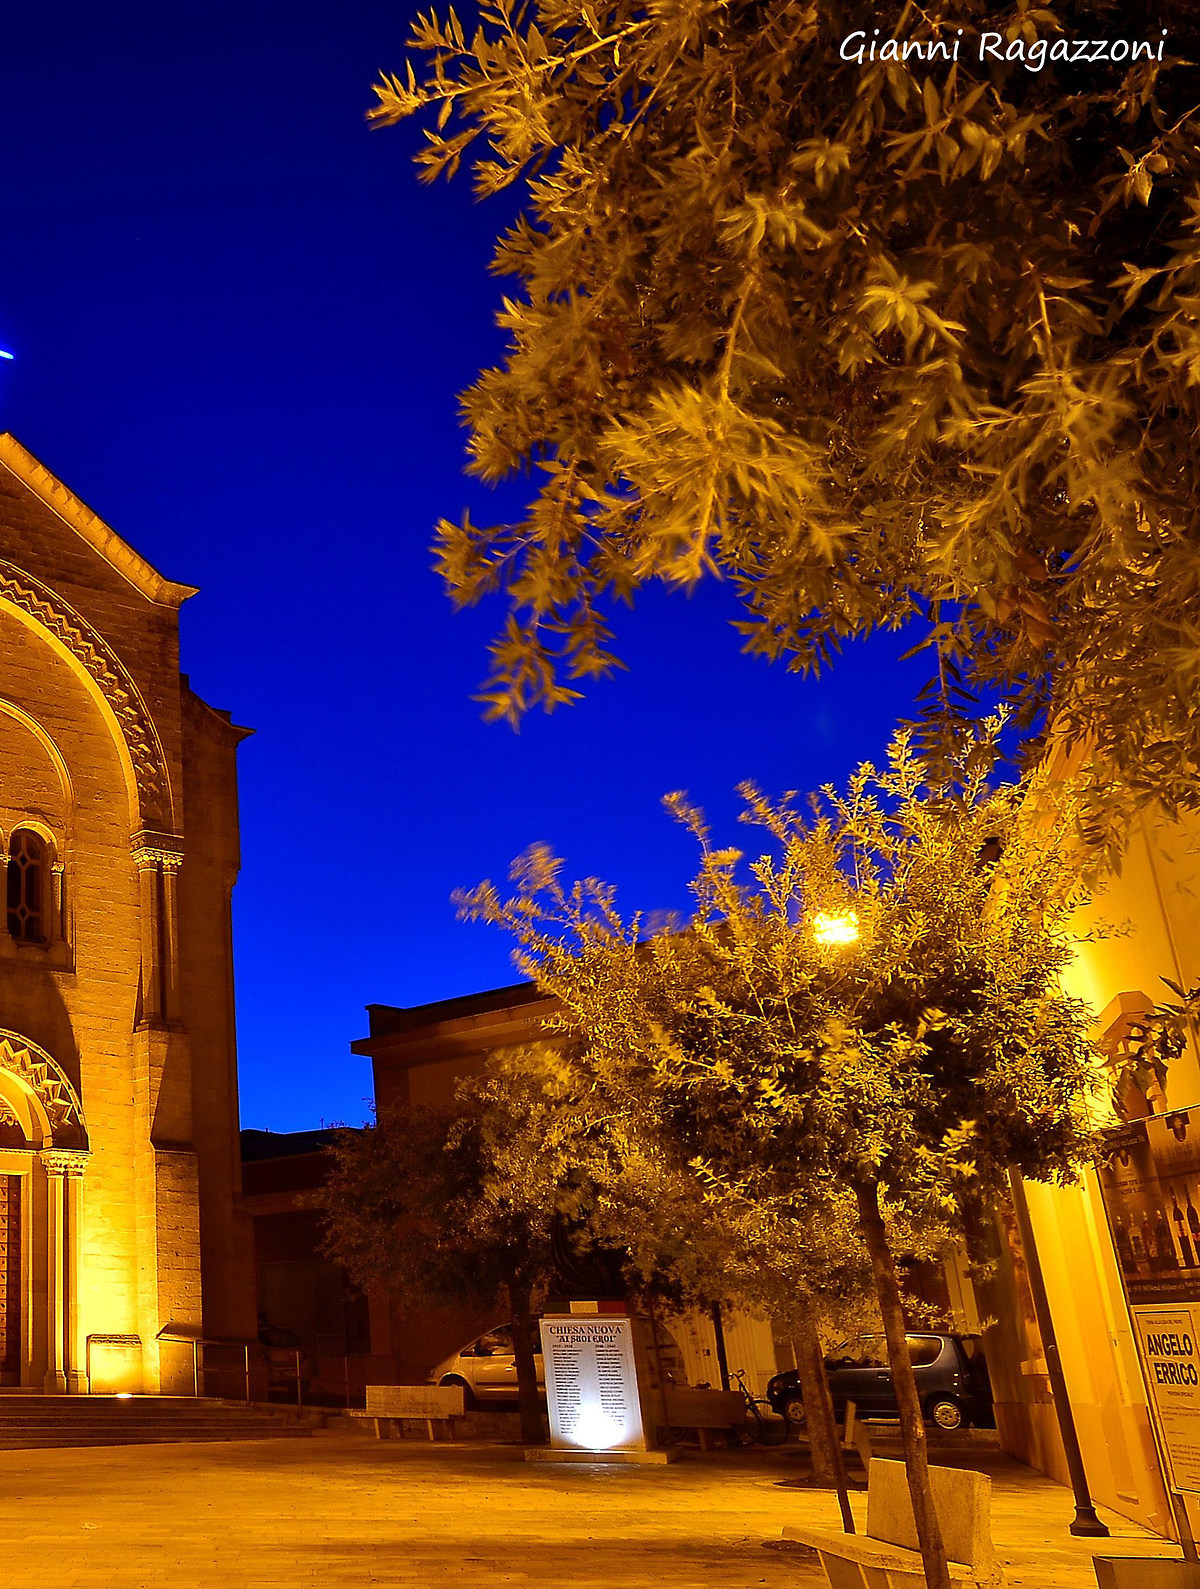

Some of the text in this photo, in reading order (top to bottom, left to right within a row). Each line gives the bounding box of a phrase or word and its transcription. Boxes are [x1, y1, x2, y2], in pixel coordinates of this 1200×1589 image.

[549, 1326, 622, 1335] CHIESA NUOVA
[1147, 1333, 1193, 1357] ANGELO
[1153, 1362, 1198, 1386] ERRICO
